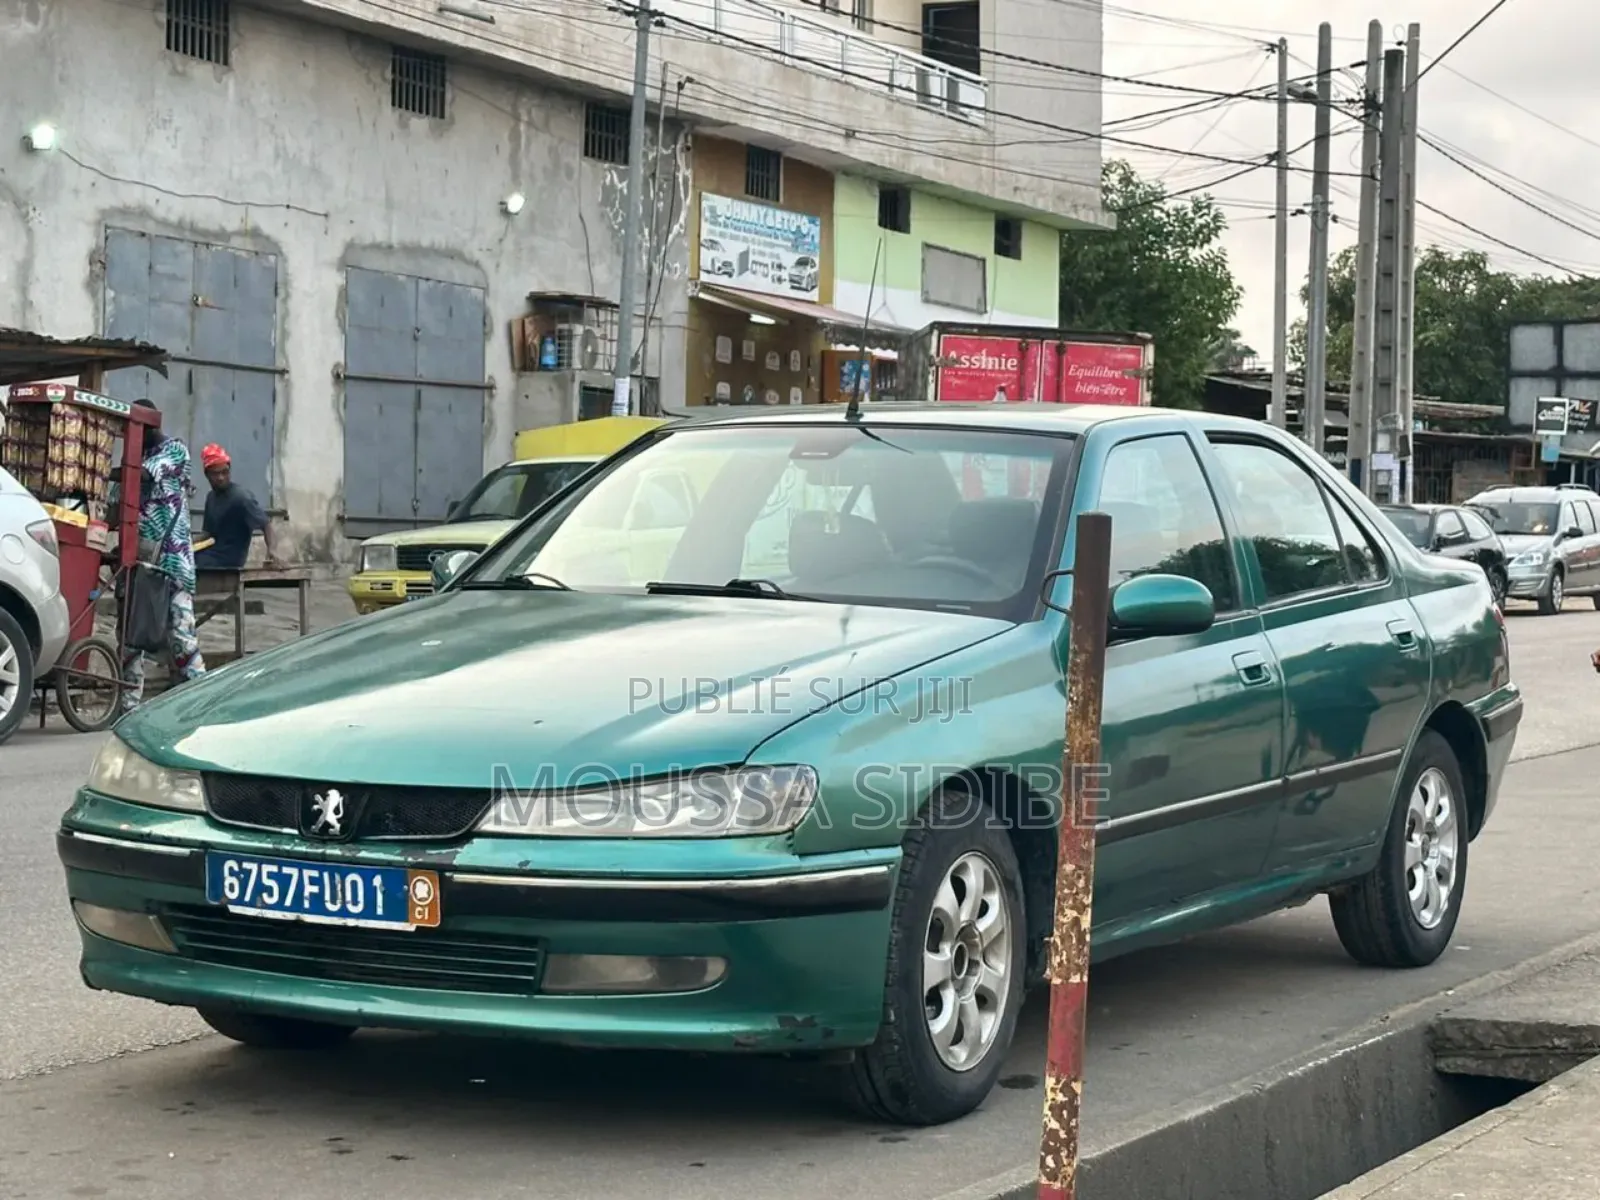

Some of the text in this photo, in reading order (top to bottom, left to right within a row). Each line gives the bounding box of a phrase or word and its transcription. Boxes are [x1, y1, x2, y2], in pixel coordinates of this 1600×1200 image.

[948, 348, 1018, 371] Assinie
[1068, 364, 1122, 379] Equilibre
[1074, 382, 1127, 396] bien-être
